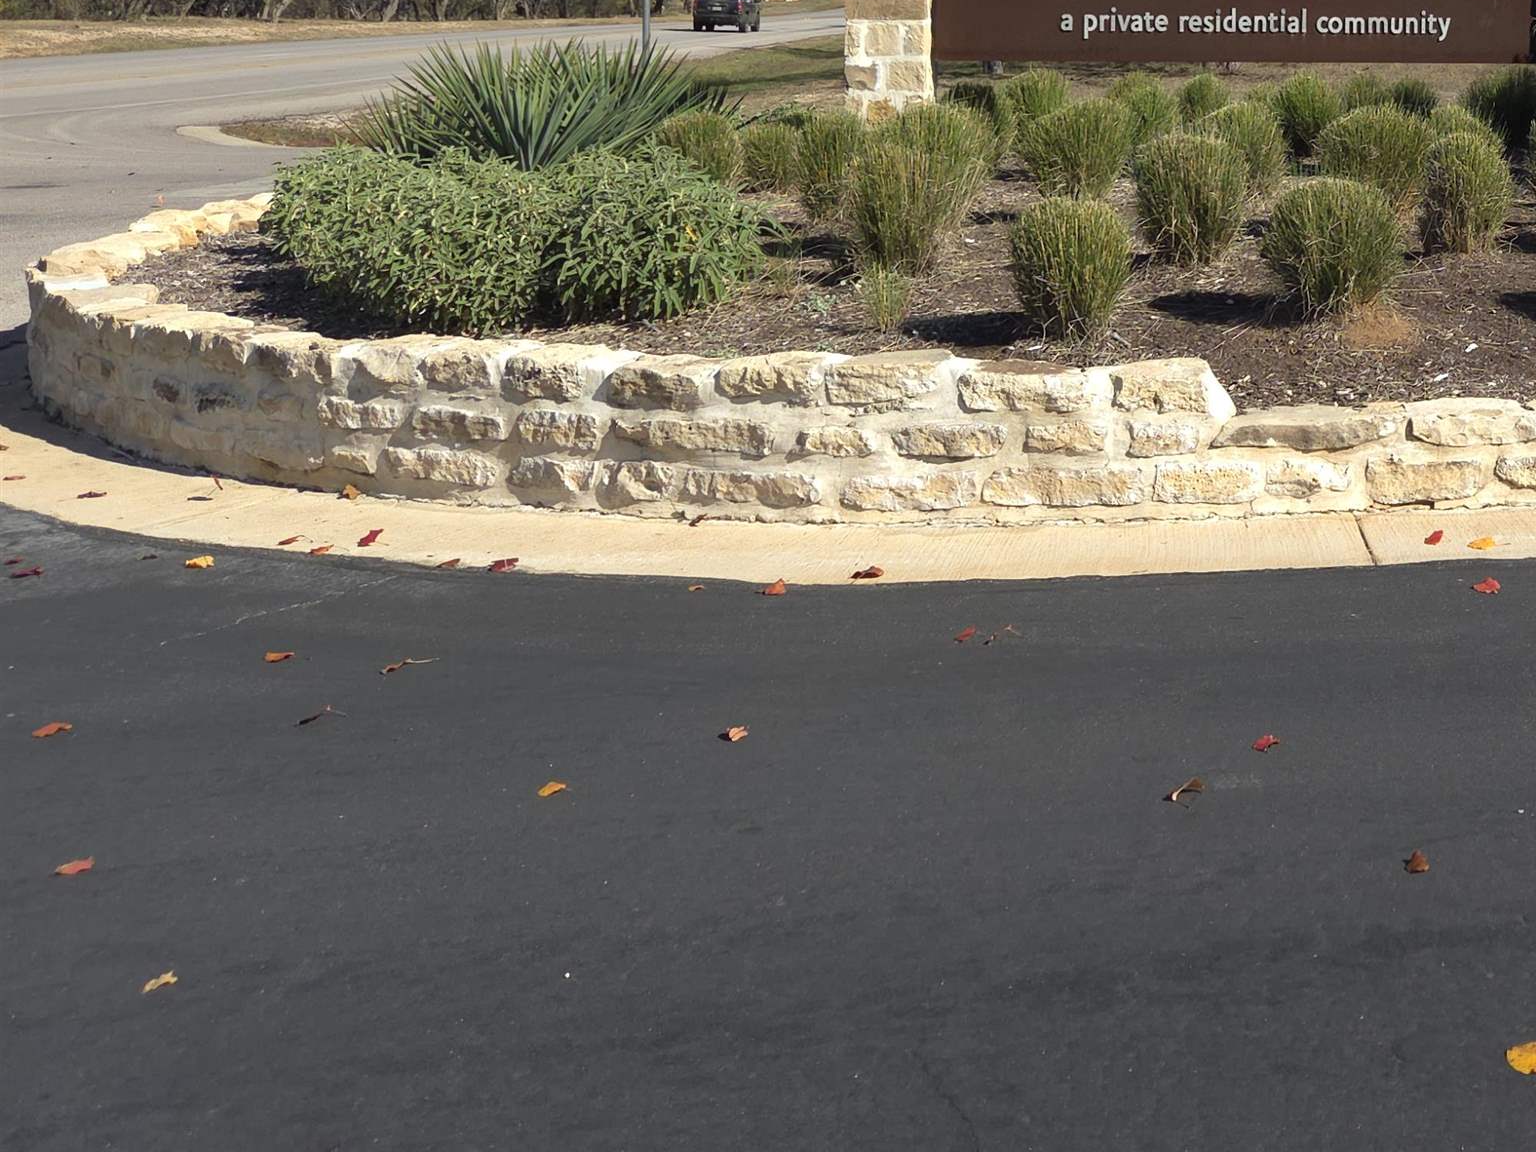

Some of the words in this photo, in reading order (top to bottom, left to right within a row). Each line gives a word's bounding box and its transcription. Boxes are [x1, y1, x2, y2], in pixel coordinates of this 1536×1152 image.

[1060, 12, 1074, 32] a
[1083, 6, 1169, 40] private
[1178, 7, 1307, 35] residential
[1315, 10, 1451, 42] community
